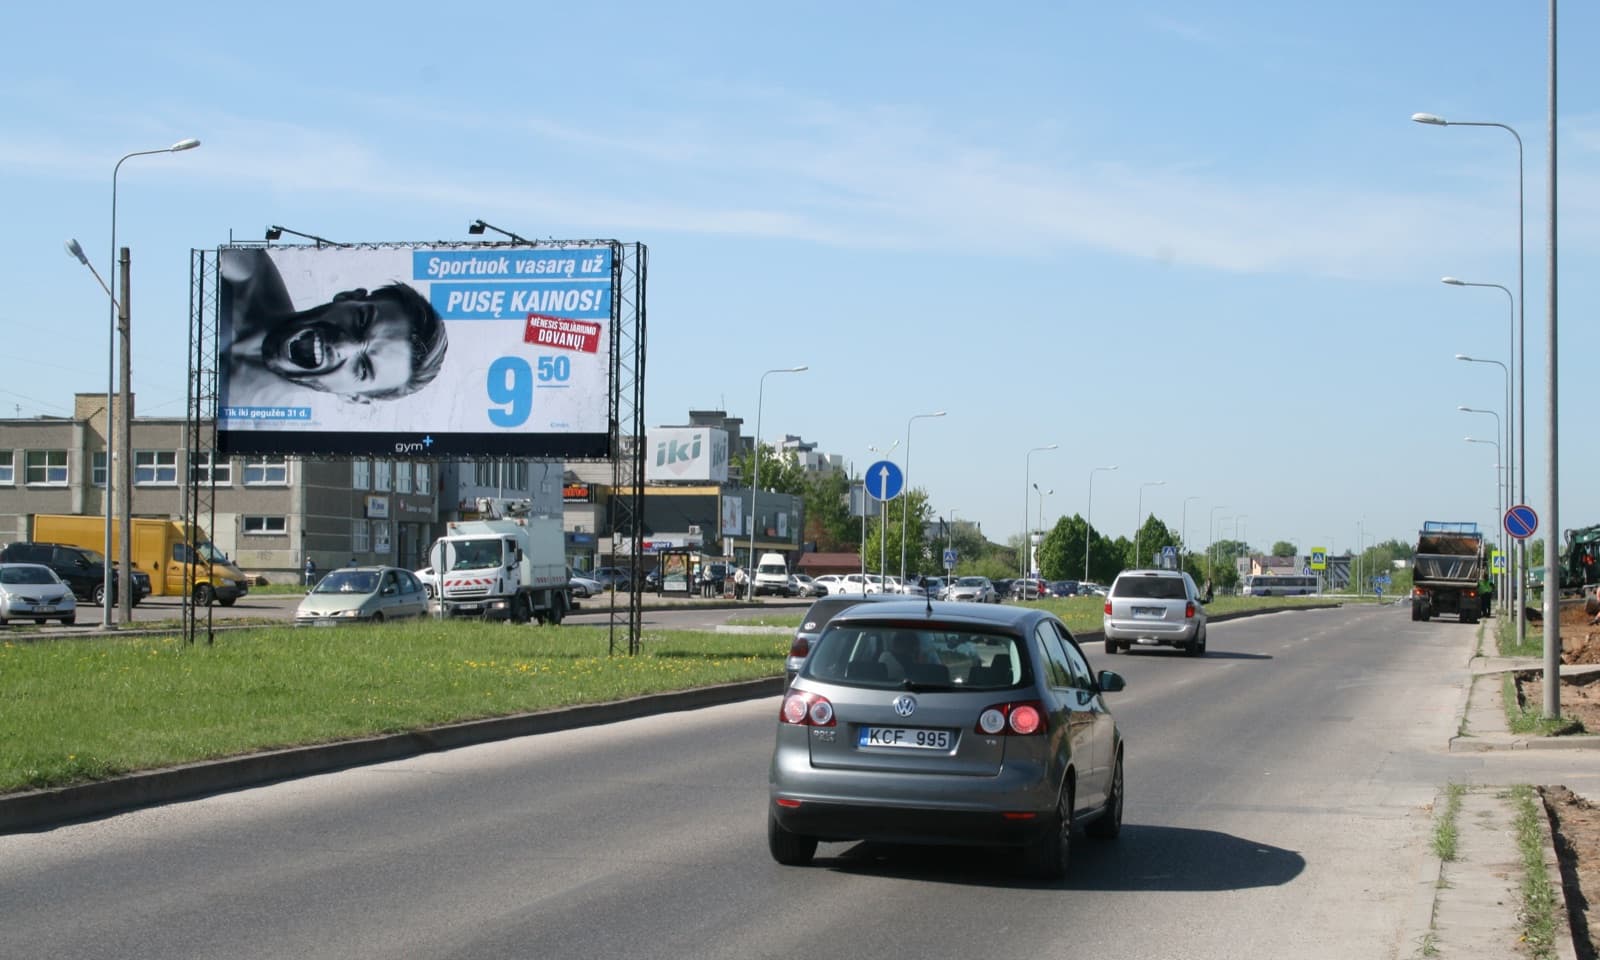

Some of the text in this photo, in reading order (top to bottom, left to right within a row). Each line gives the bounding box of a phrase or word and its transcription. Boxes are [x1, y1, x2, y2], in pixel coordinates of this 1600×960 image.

[428, 255, 604, 278] Sportuok vasarą už
[447, 289, 603, 318] PUSĘ KAINOS!
[538, 329, 585, 352] DOVANŲ!
[537, 355, 570, 381] 50
[224, 408, 236, 417] Tik
[238, 408, 249, 417] iki
[287, 408, 297, 417] 31
[656, 433, 702, 467] iki
[869, 728, 947, 748] KCF 995
